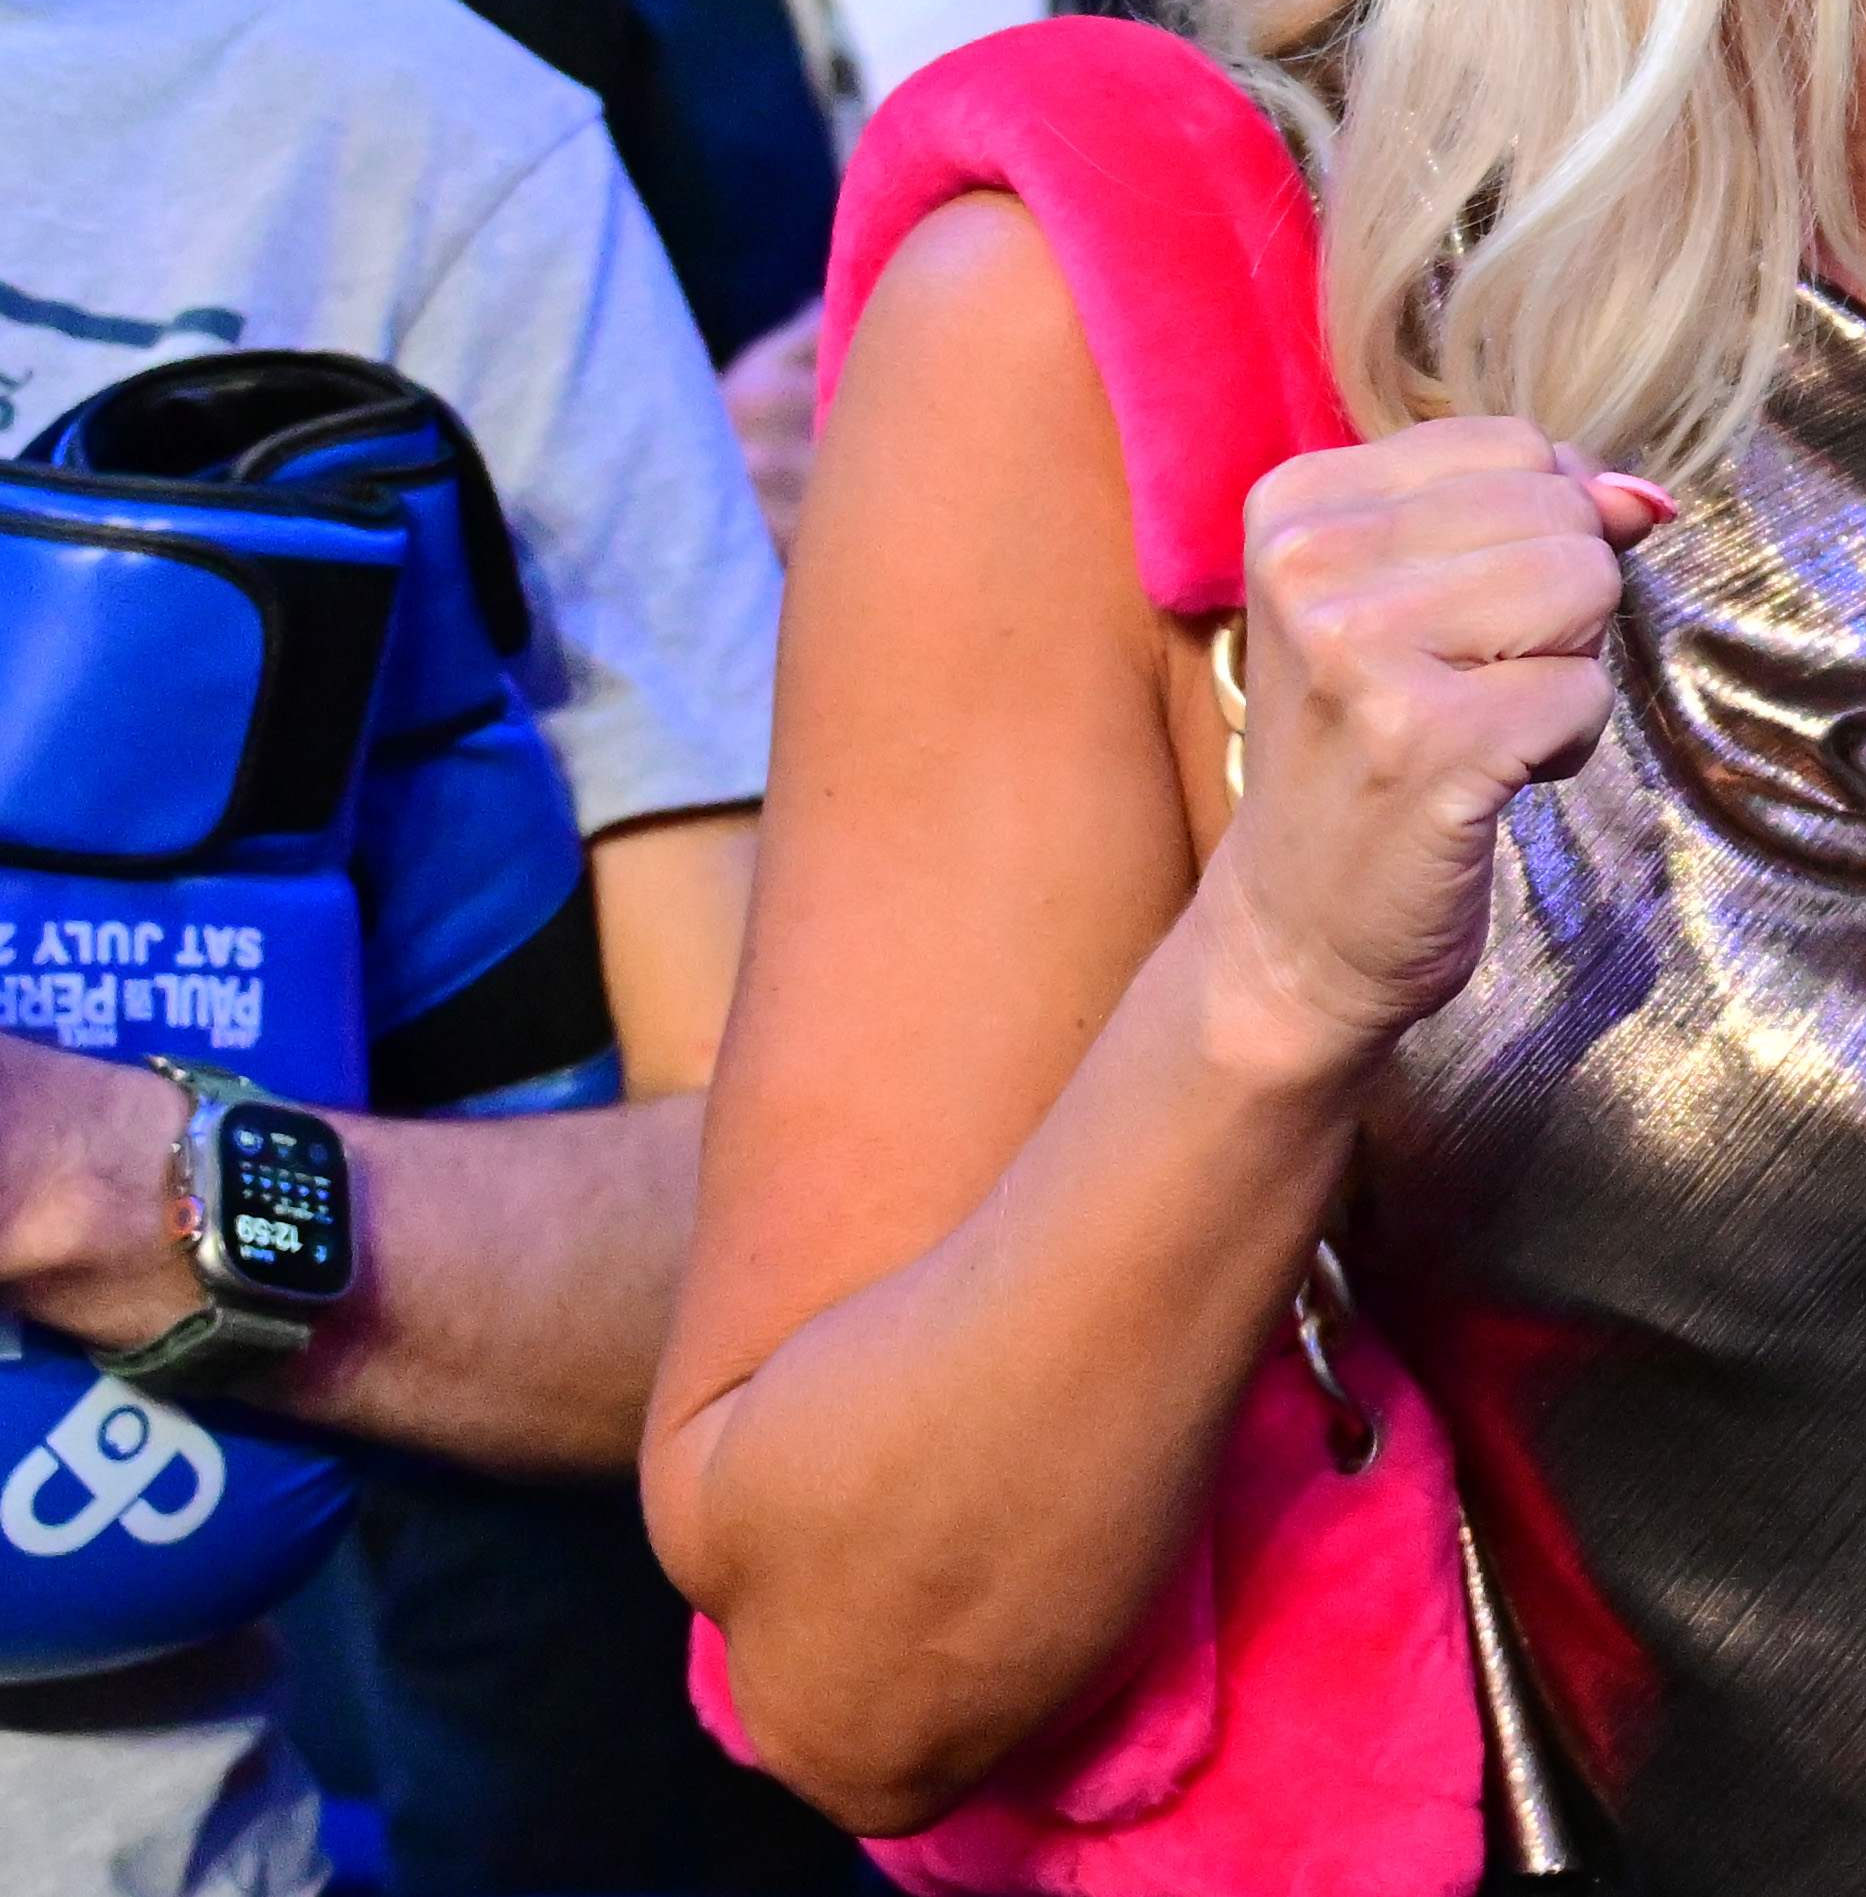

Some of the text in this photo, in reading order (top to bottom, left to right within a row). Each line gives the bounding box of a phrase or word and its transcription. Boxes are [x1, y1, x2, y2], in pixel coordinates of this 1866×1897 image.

[33, 920, 164, 966] JULY
[176, 923, 263, 969] SAT
[154, 972, 263, 1029] PAUL
